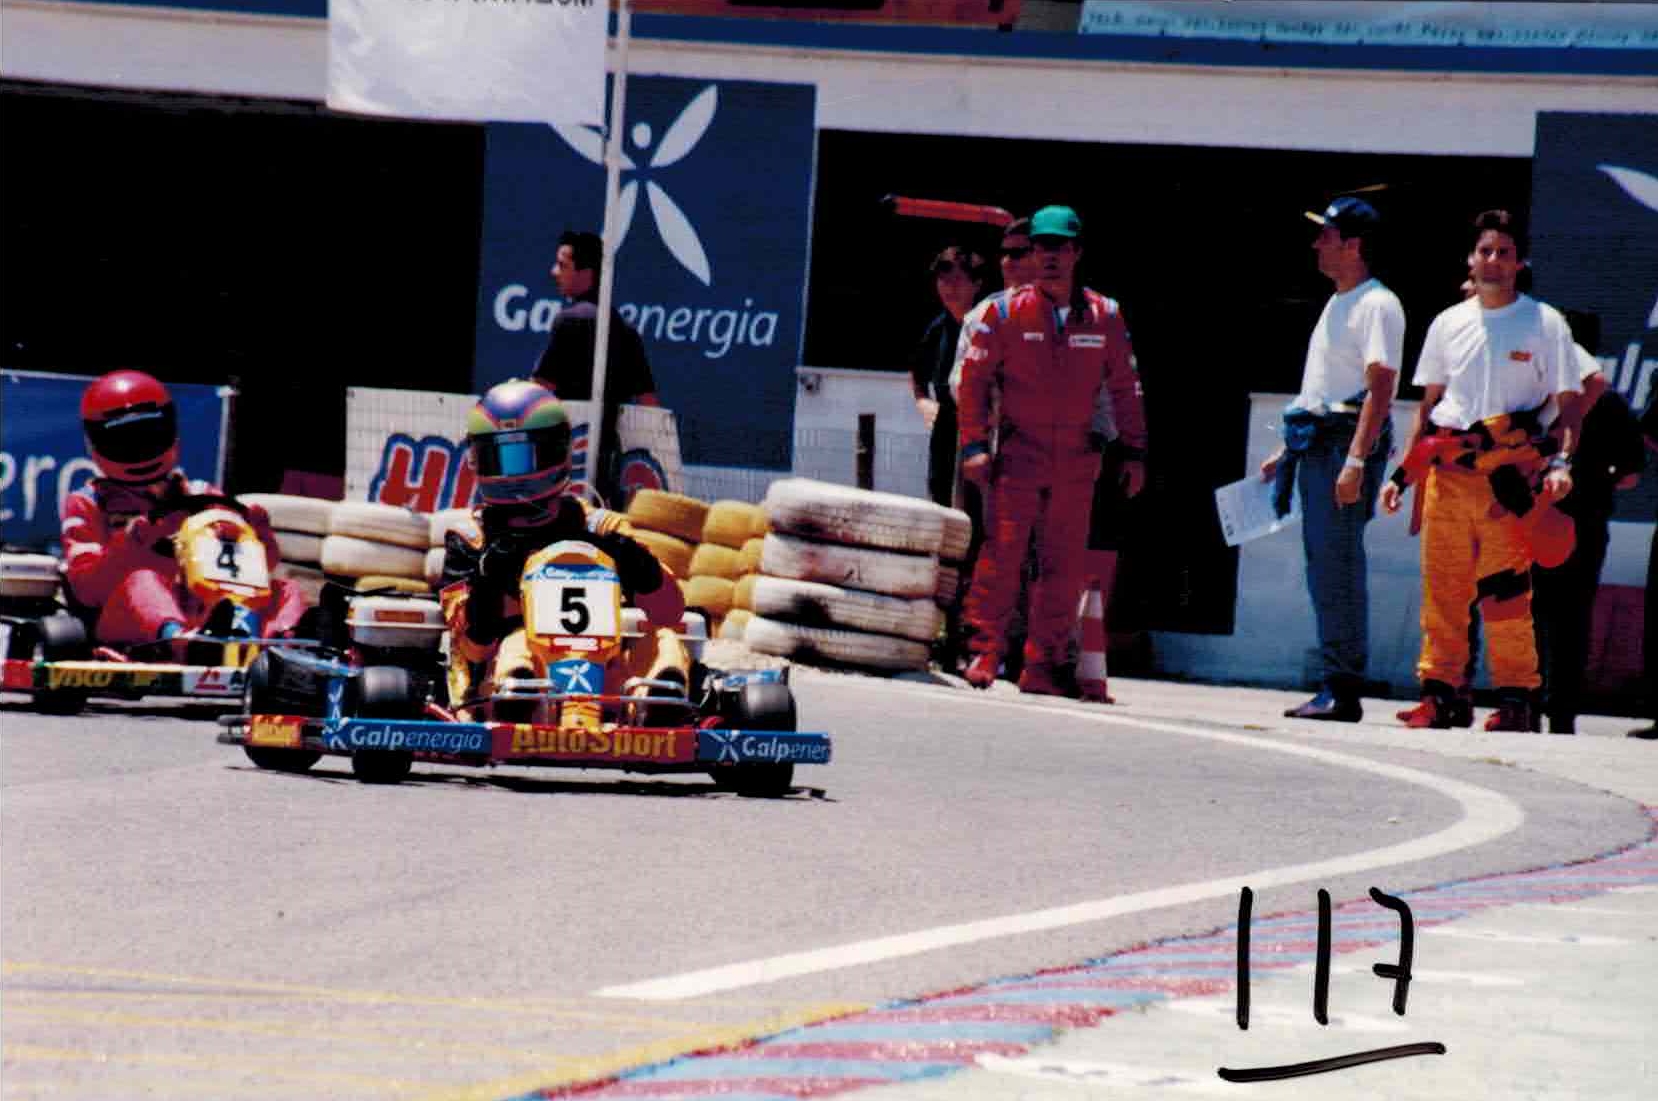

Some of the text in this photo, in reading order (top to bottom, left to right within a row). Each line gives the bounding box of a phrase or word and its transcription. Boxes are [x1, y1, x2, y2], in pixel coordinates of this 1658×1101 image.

[218, 540, 240, 578] 4
[560, 586, 591, 635] 5
[350, 724, 485, 754] Galpenergia
[510, 724, 677, 758] AutoSport
